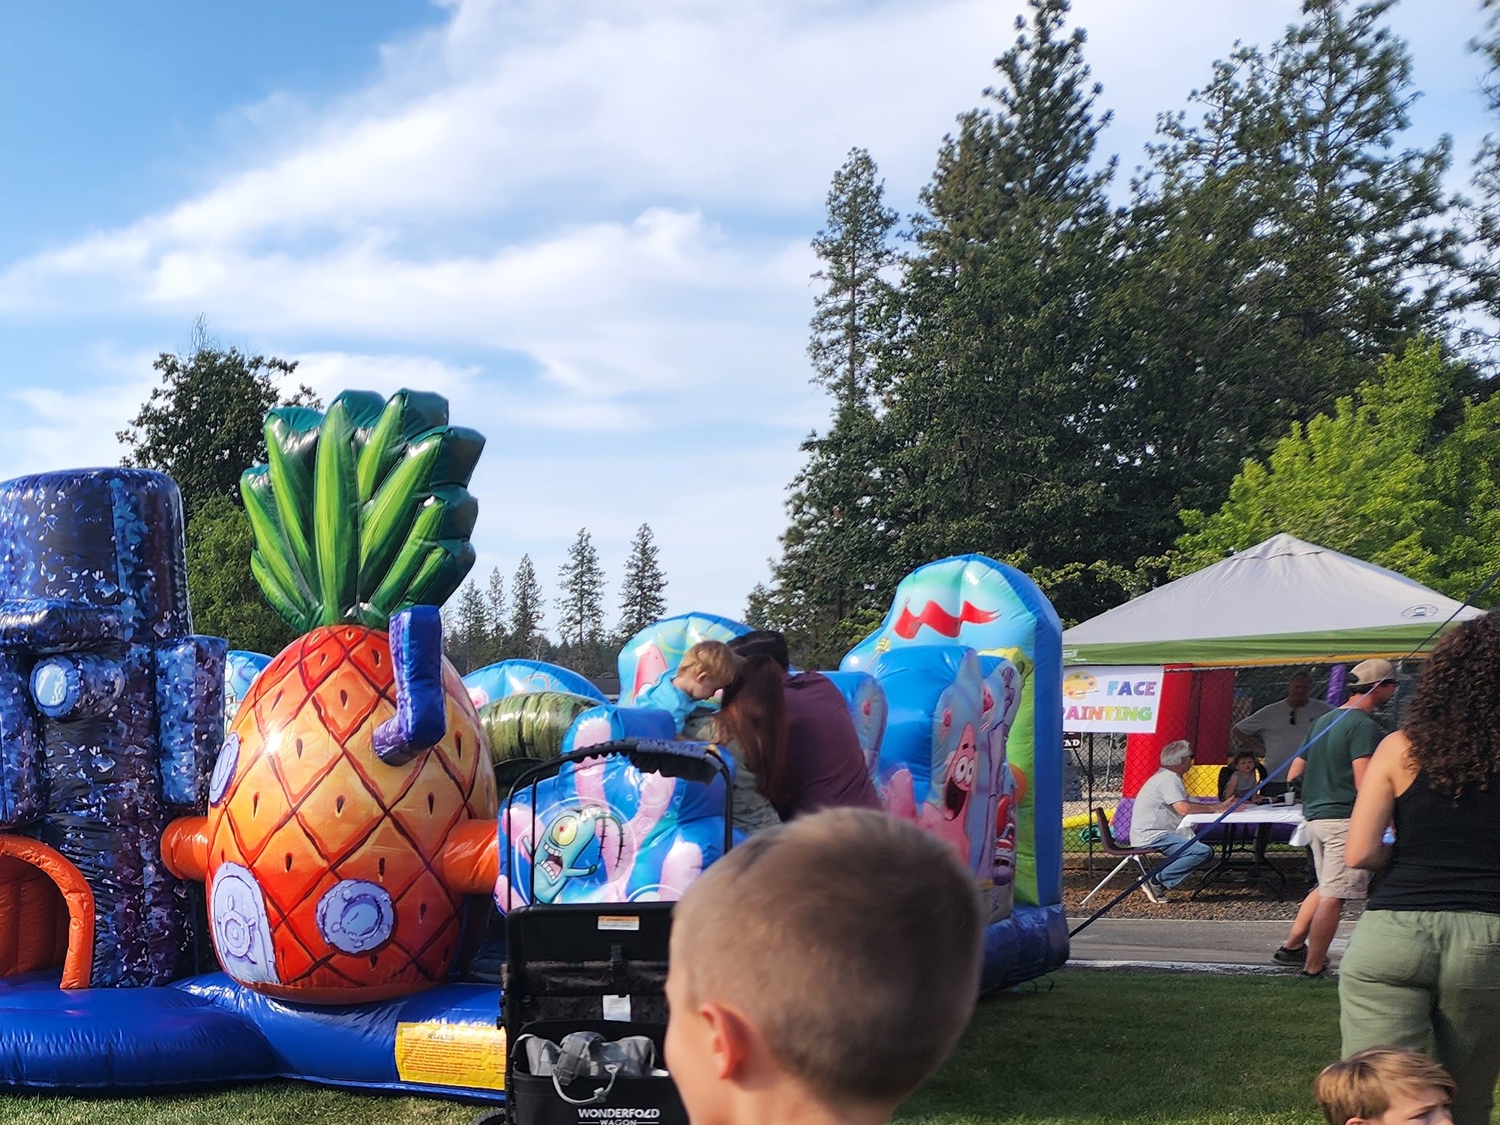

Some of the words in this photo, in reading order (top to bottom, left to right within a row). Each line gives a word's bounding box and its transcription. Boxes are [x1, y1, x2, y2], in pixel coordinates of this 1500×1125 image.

[1107, 681, 1157, 696] FACE
[1063, 706, 1152, 721] AINTING
[577, 1108, 660, 1119] WONDERFOLD
